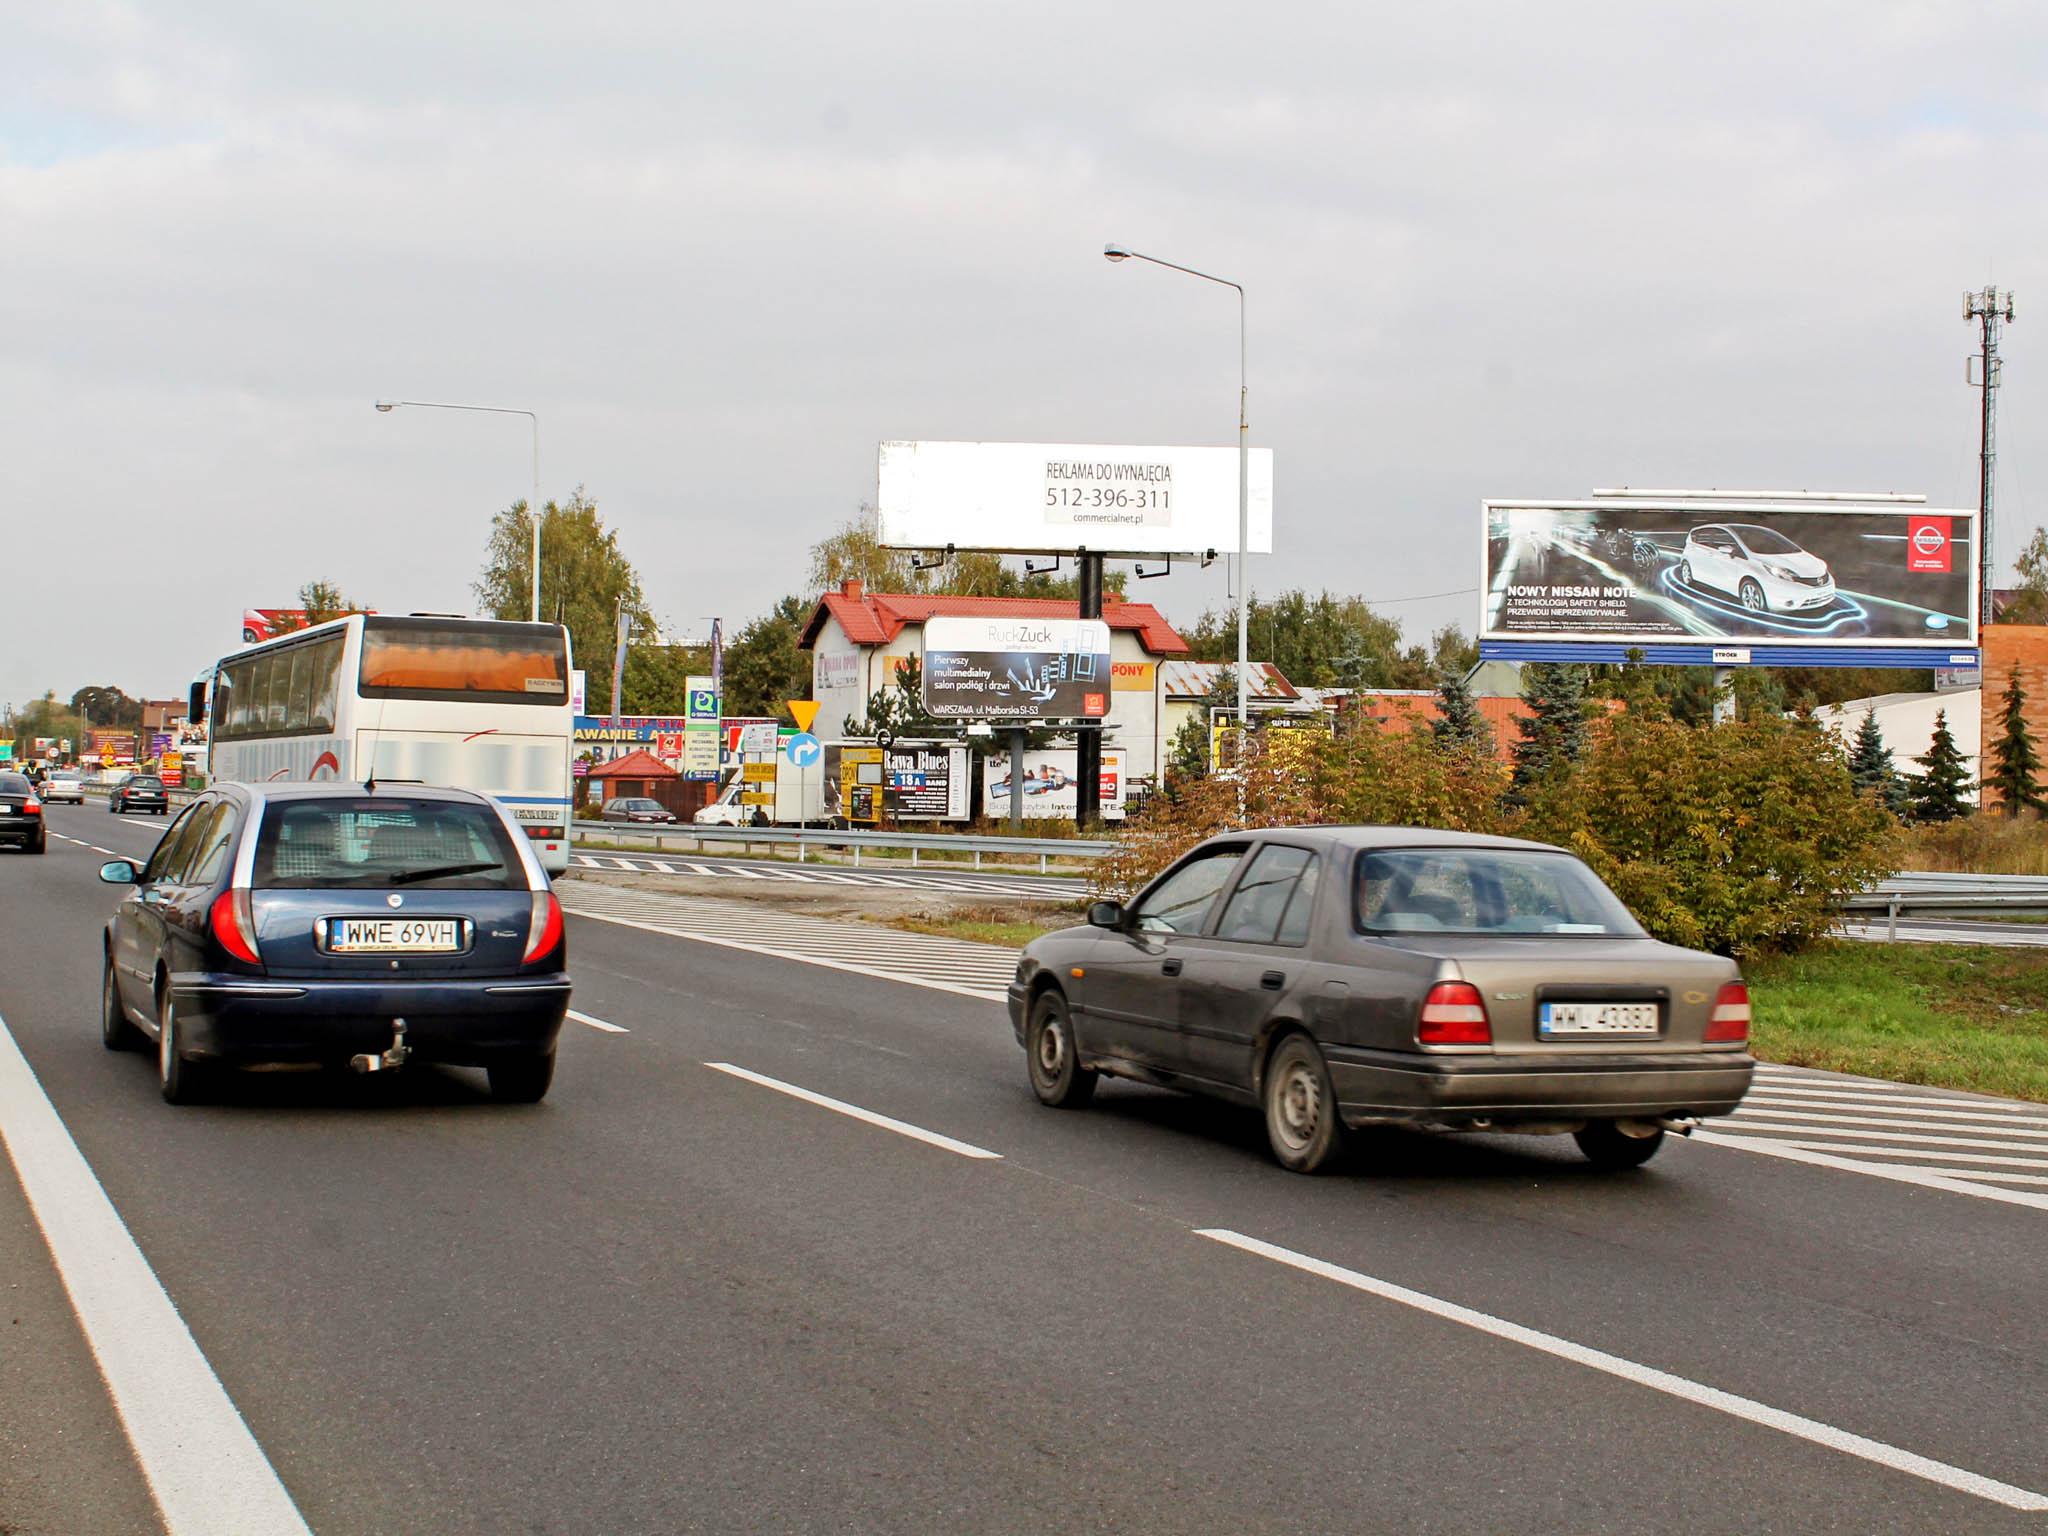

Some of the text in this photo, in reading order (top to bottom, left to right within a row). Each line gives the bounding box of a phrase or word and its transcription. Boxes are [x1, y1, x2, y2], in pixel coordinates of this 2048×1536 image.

[1046, 462, 1172, 486] REKLAMA DO WYNAJĘCIA
[1046, 487, 1169, 508] 512-396-311
[1073, 513, 1144, 525] commercialnet.pl
[1507, 585, 1637, 598] NOWY NISSAN NOTE
[1506, 598, 1628, 609] Z TECHNOLOGIĄ SAFETY SHIELD.
[1506, 608, 1629, 618] PRZEWIDUJ NIEPRZEWIDYWALNE.
[988, 625, 1052, 643] RuckZuck
[934, 655, 969, 667] Pierwszy
[934, 667, 991, 680] multimedialny
[934, 681, 955, 690] salon
[956, 680, 983, 693] podłóg
[989, 680, 1010, 690] drzwi
[933, 705, 1039, 715] WARSZAWA ul. Malborska 51-53
[574, 728, 643, 740] AWANIE:
[884, 750, 914, 770] Rawa
[917, 751, 949, 770] Blues
[348, 922, 453, 943] WWE 69VH
